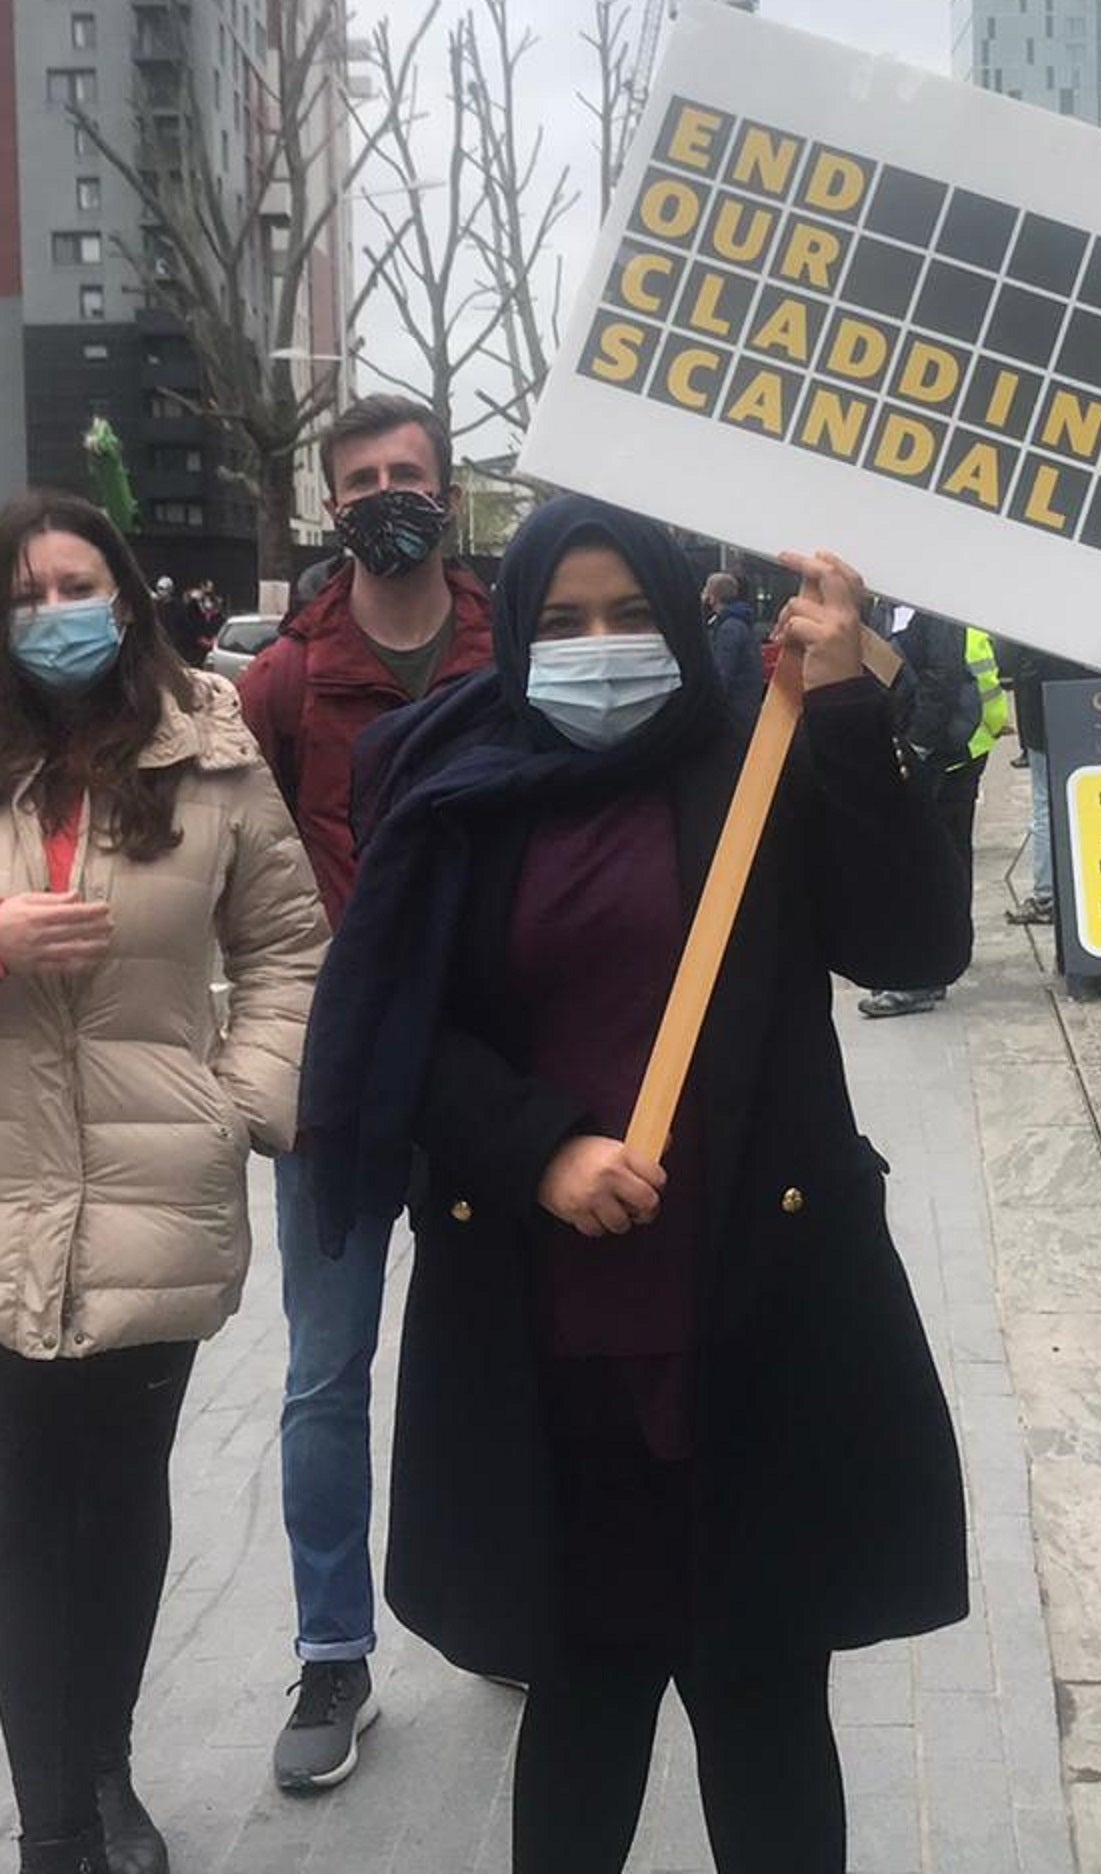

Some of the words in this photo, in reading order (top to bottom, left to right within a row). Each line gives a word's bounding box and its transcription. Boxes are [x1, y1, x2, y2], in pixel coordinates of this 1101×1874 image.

[666, 104, 866, 213] END
[638, 179, 842, 289] OUR
[591, 323, 1066, 530] SCANDAL
